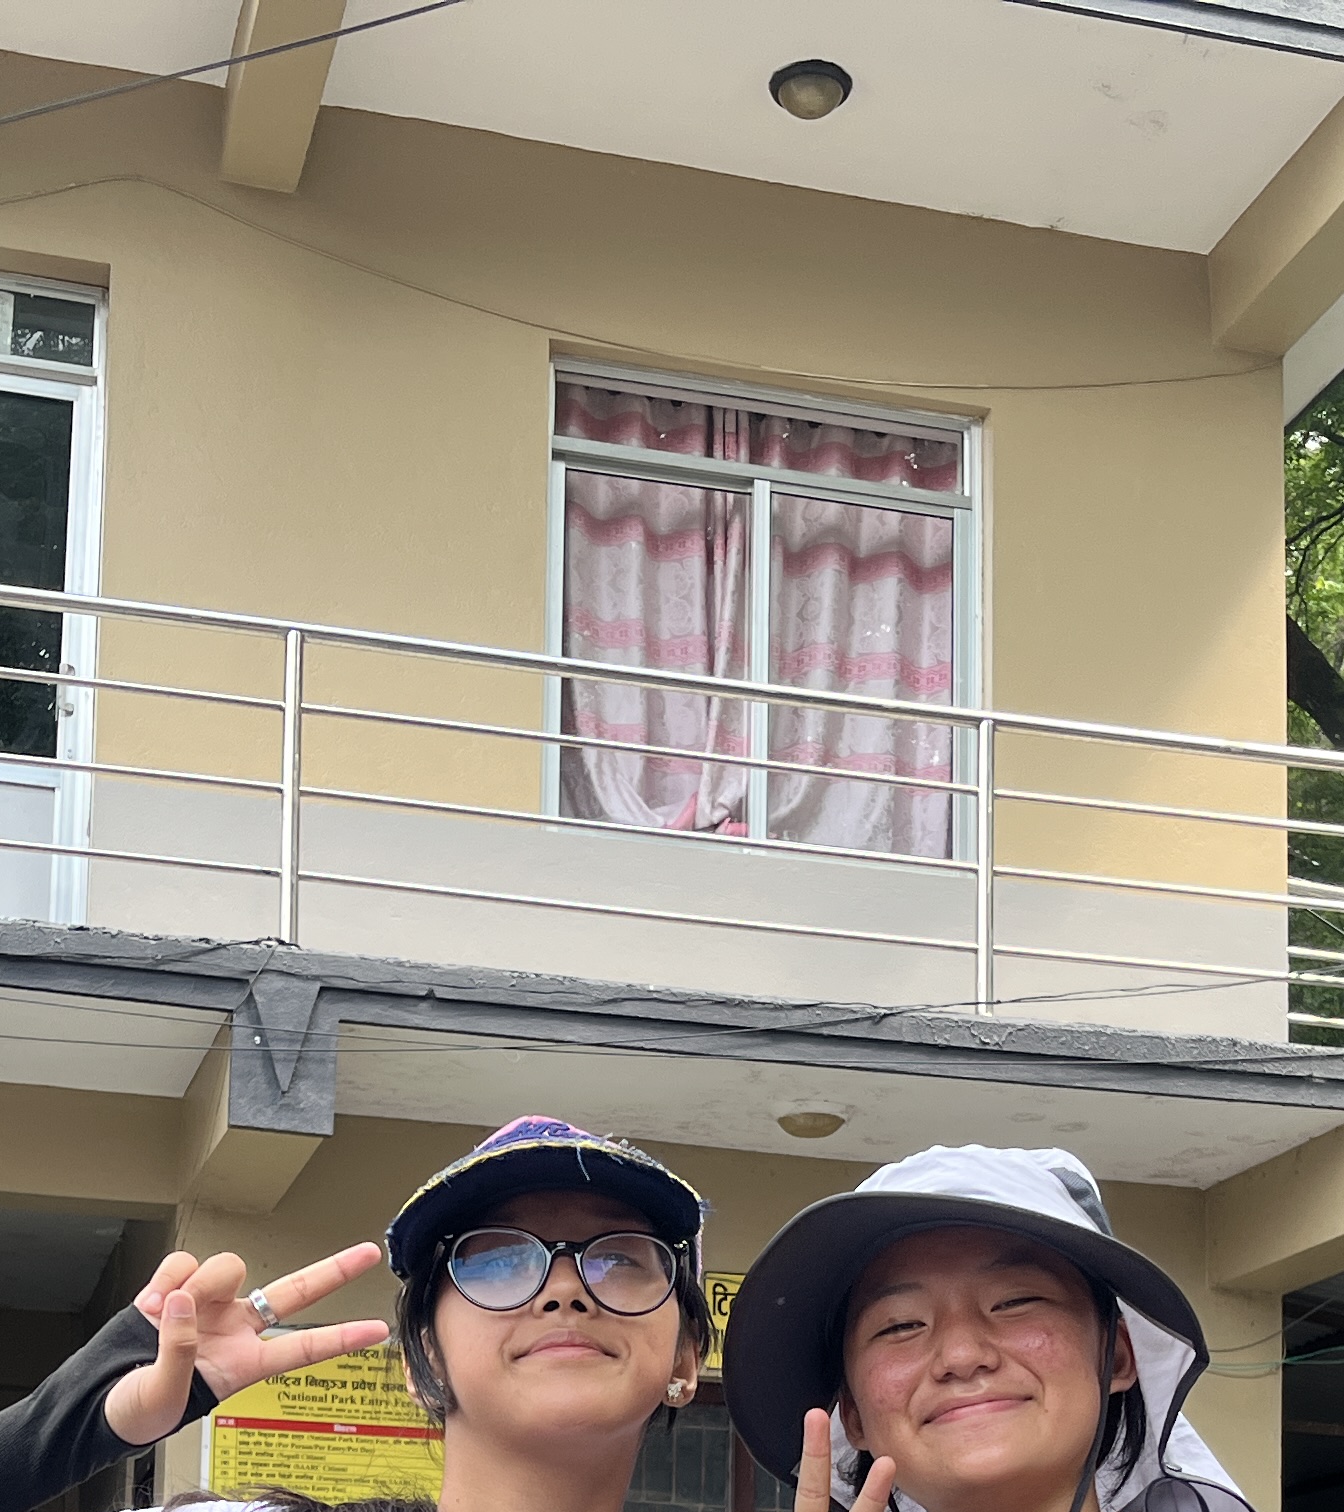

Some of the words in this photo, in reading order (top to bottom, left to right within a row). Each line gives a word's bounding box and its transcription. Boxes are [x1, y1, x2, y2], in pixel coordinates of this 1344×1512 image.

[277, 1391, 328, 1405] (National
[331, 1393, 357, 1405] Park
[360, 1396, 389, 1409] Entry
